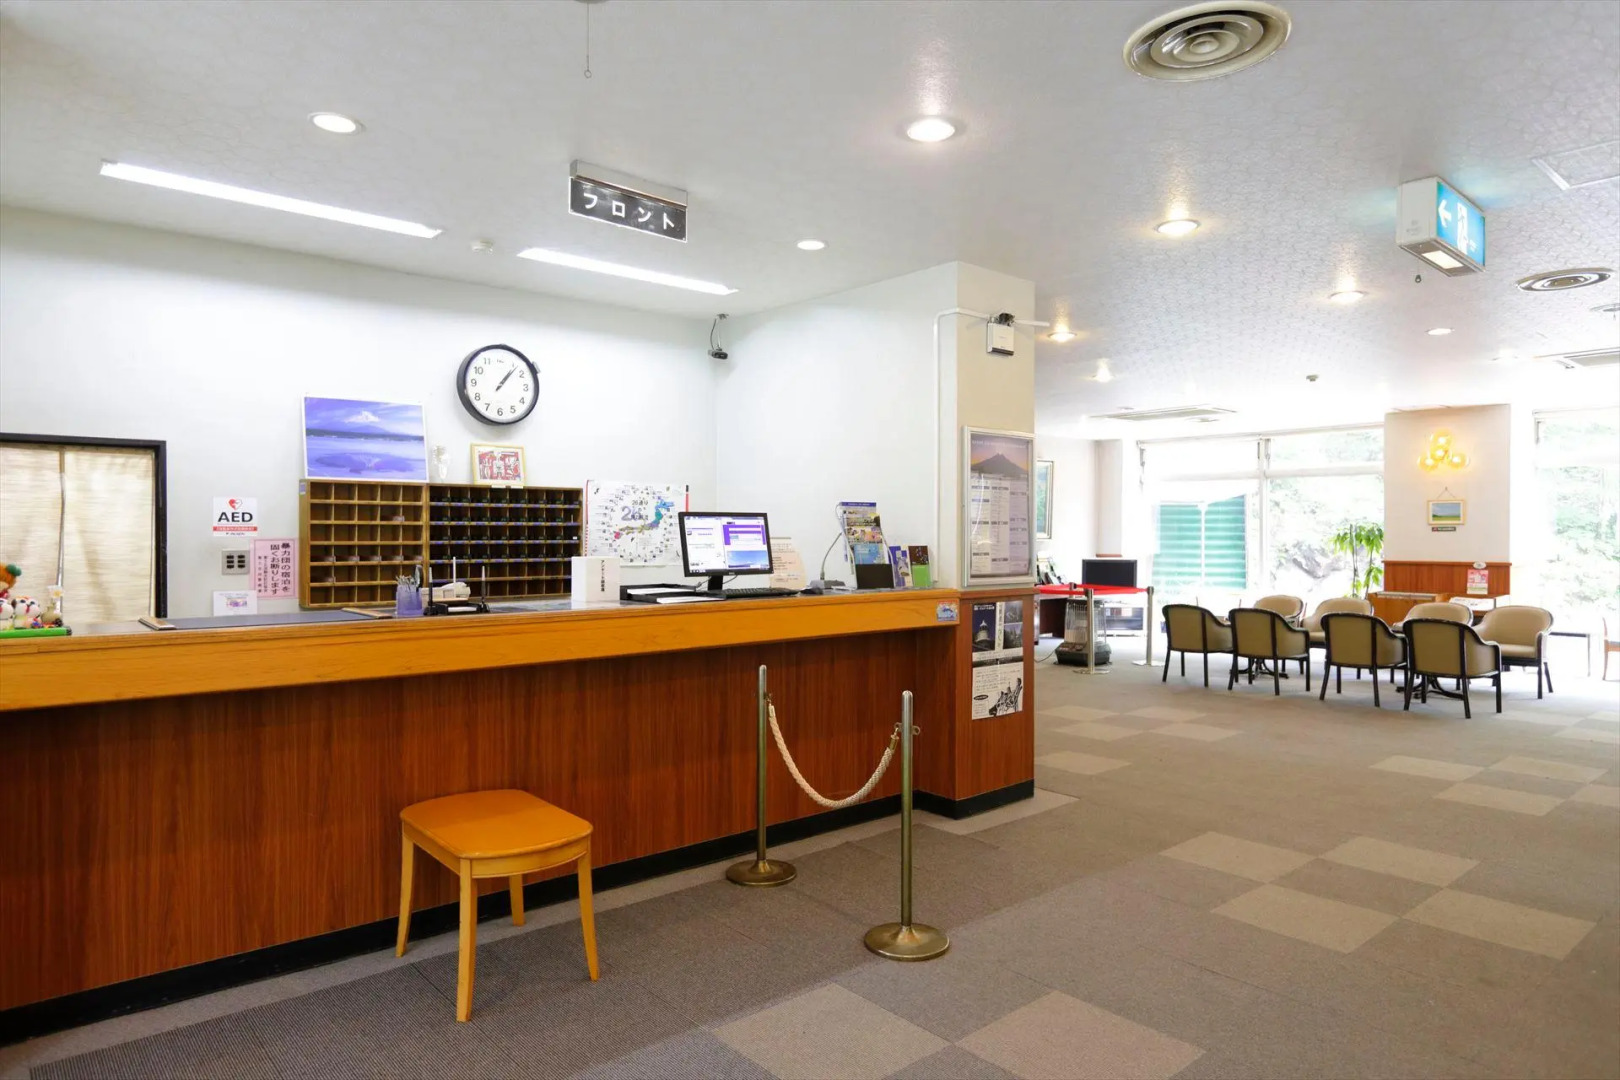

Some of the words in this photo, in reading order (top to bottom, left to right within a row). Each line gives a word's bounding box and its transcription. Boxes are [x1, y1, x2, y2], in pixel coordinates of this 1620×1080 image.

[583, 192, 675, 230] フロント
[474, 366, 484, 375] 10
[519, 370, 525, 378] 2
[471, 378, 477, 387] 9
[523, 384, 529, 392] 3
[474, 393, 481, 401] 8
[519, 397, 525, 405] 4
[485, 403, 490, 411] 7
[497, 408, 503, 416] 6
[218, 512, 253, 522] AED
[270, 544, 280, 595] 固くお断りします
[281, 543, 291, 592] 暴力団の宿泊を
